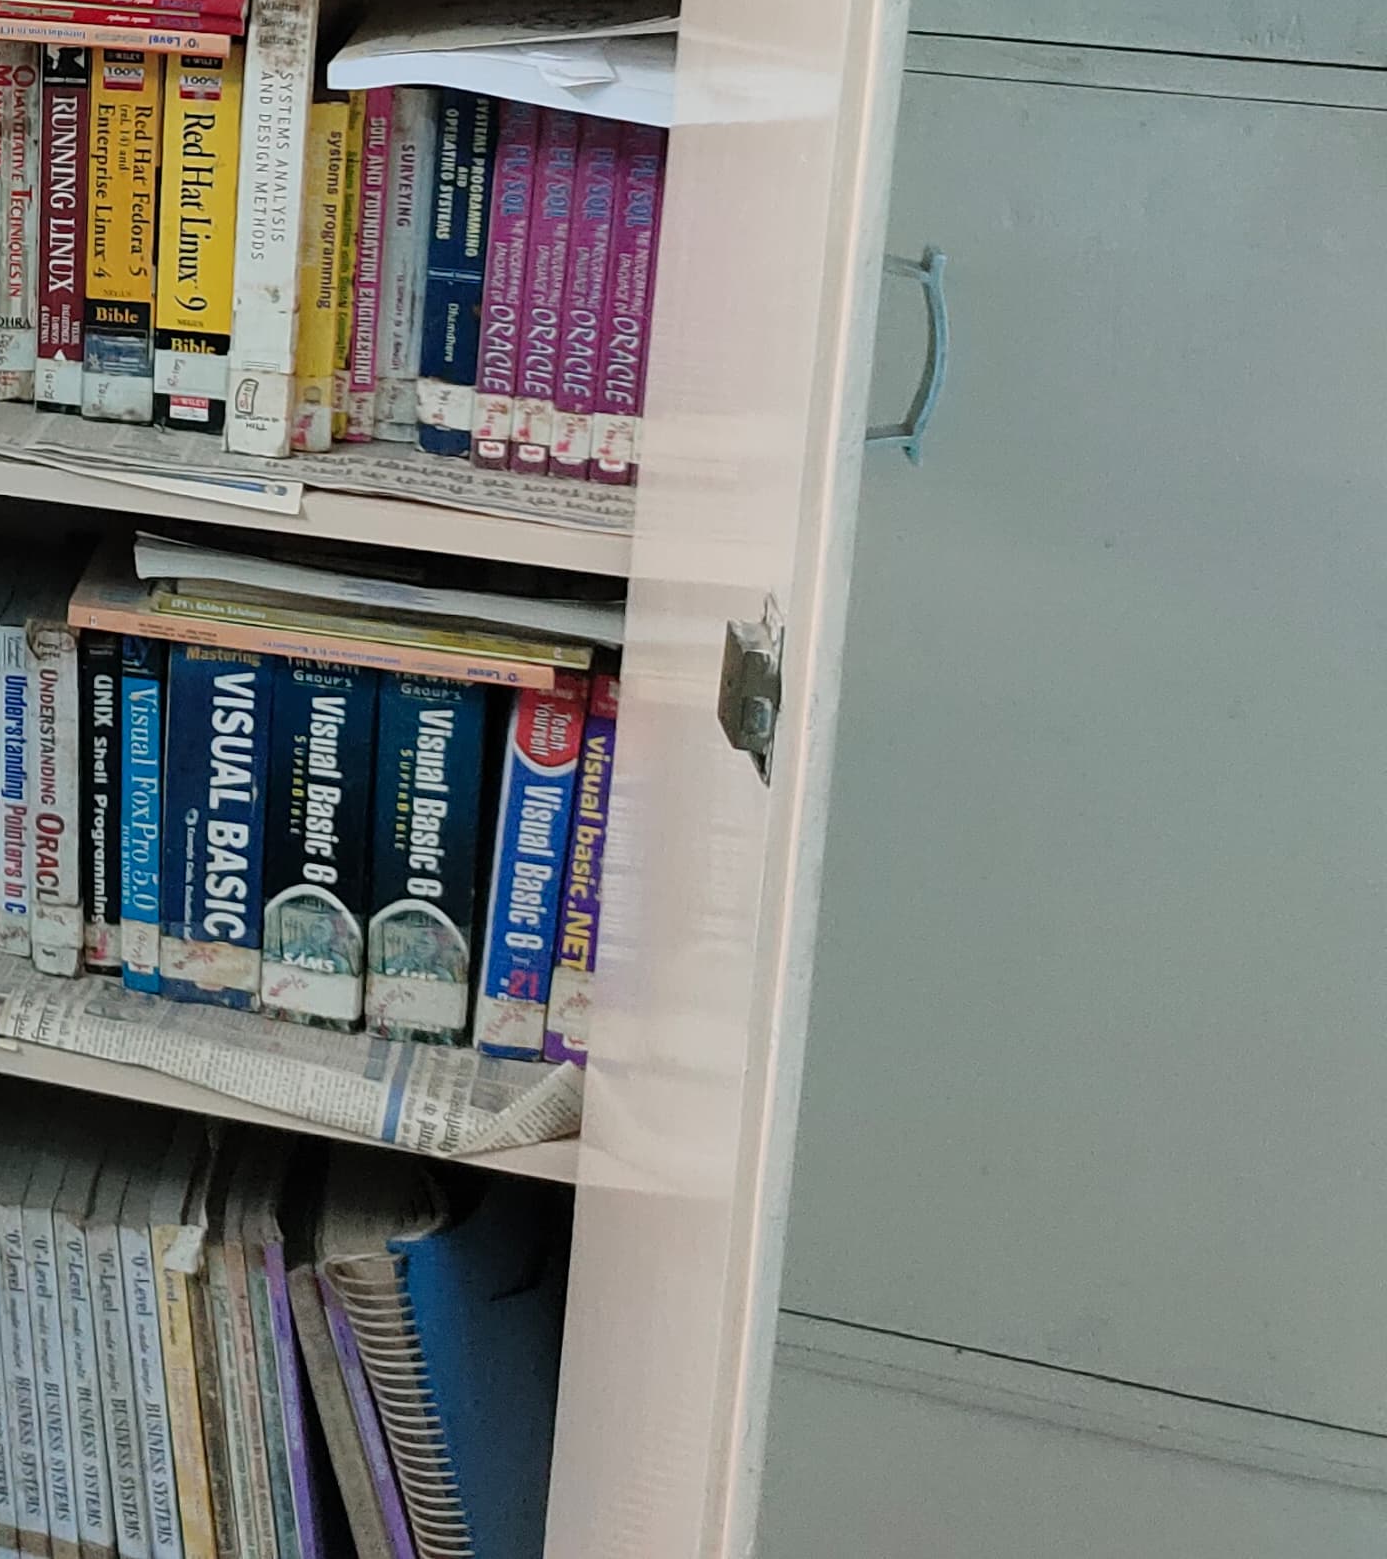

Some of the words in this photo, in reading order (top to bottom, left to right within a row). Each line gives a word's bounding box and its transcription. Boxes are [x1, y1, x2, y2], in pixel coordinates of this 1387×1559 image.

[50, 96, 77, 210] RUNNING
[96, 103, 115, 200] Enterprise
[182, 112, 216, 163] Red
[181, 166, 214, 210] Hat
[397, 144, 415, 228] SURVEYING
[47, 217, 74, 296] LINUX
[177, 215, 212, 282] Linux
[96, 306, 139, 324] Bible
[483, 303, 515, 392] ORACLE
[523, 308, 557, 395] ORACLE
[92, 674, 114, 728] UNIX
[129, 683, 159, 767] Visual
[207, 672, 257, 811] VISUAL
[307, 695, 347, 786] Visual
[92, 736, 108, 784] Shell
[414, 708, 455, 796] Visual
[129, 776, 158, 852] FoxPro
[304, 787, 342, 858] Basic
[409, 796, 449, 871] Basic
[201, 819, 250, 941] BASIC
